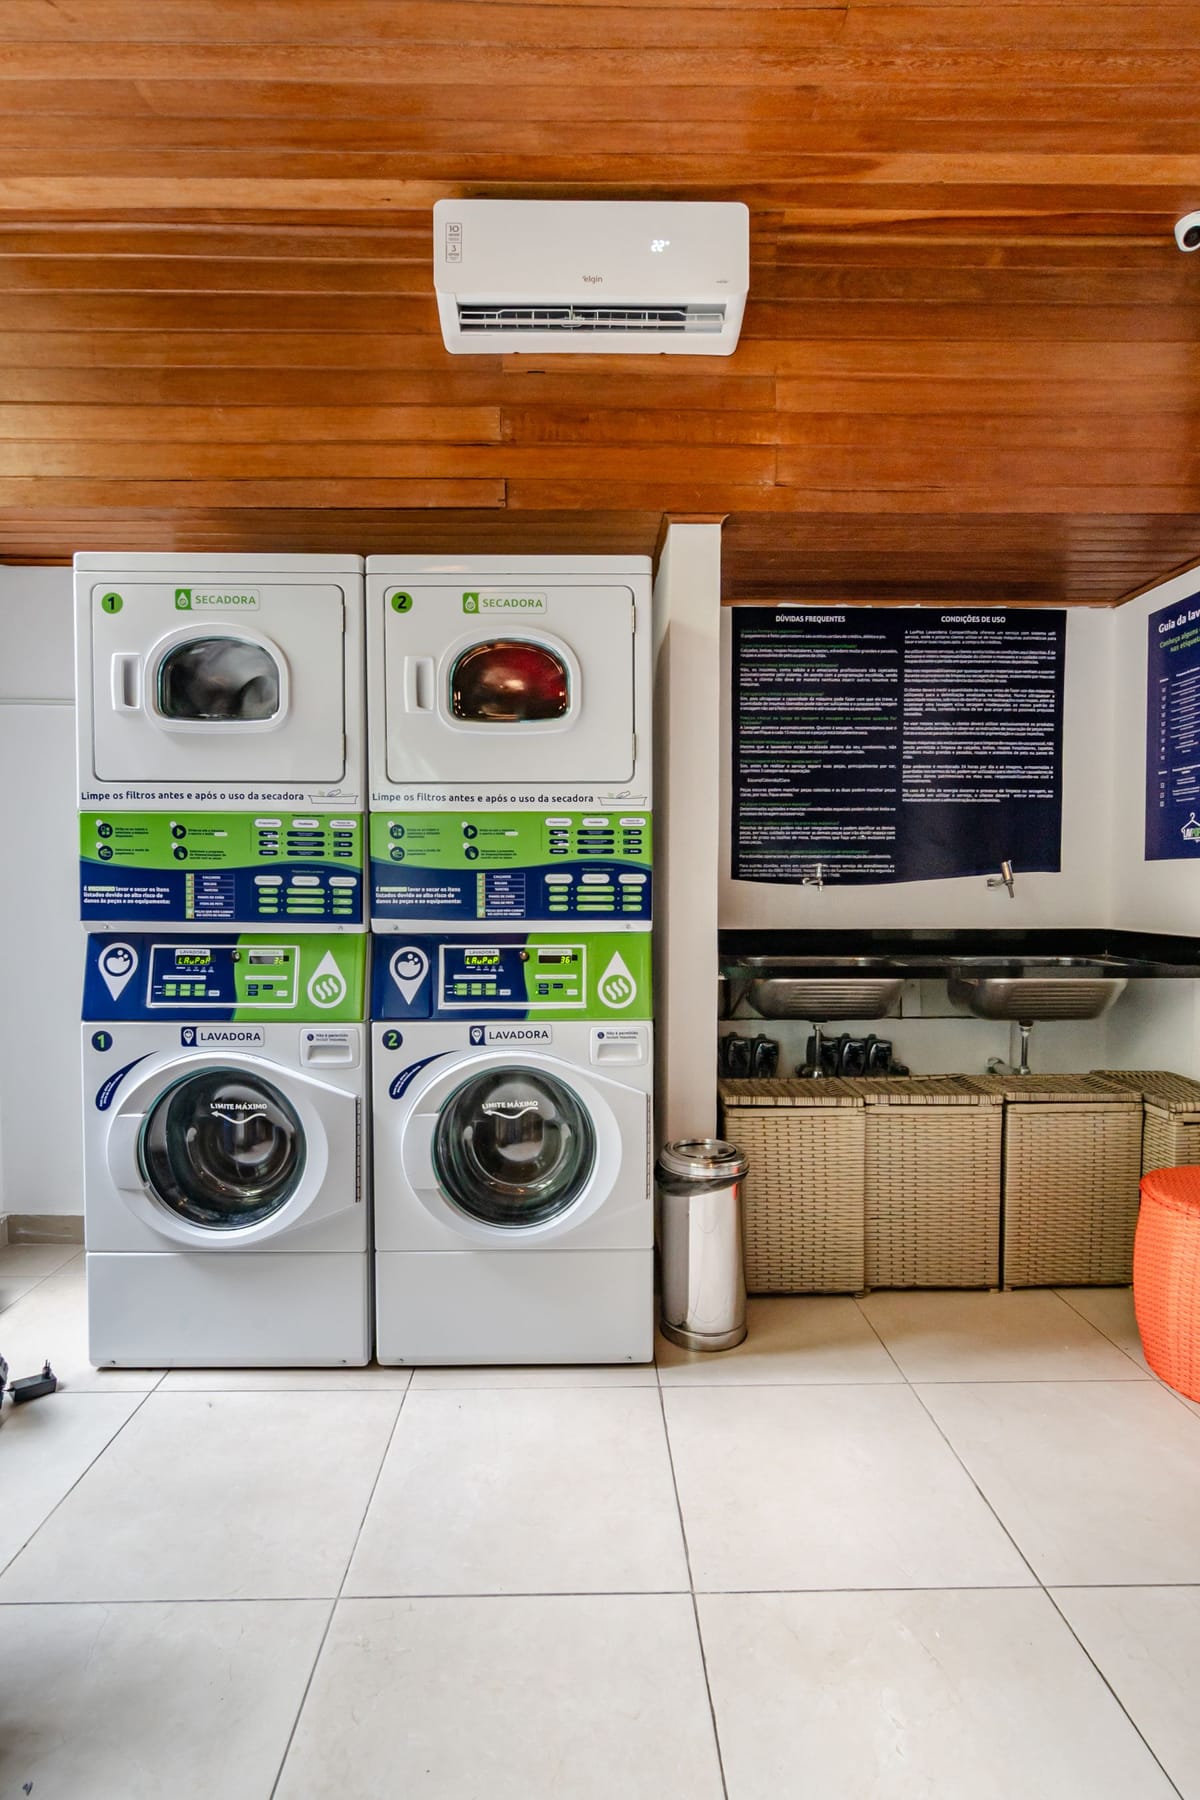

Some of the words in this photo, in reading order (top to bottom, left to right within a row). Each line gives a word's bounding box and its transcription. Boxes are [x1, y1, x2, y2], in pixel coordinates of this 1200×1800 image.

[449, 225, 459, 233] 10
[583, 275, 603, 285] elgin
[107, 596, 115, 610] 1
[195, 595, 256, 605] SECADORA
[398, 595, 407, 609] 2
[482, 598, 543, 608] SECADORA
[775, 614, 804, 623] DÚVIDAS
[805, 615, 846, 624] FREQUENTES
[941, 614, 981, 624] CONDIÇÕES
[1159, 619, 1176, 633] Guia
[1177, 614, 1187, 626] da
[81, 791, 110, 802] Limpe
[126, 790, 156, 800] filtros
[158, 792, 185, 800] antes
[195, 791, 218, 803] após
[249, 791, 259, 800] da
[261, 790, 304, 801] secadora
[372, 792, 401, 803] Limpe
[403, 794, 415, 802] os
[416, 791, 447, 802] filtros
[448, 793, 476, 803] antes
[485, 792, 508, 804] após
[518, 795, 536, 803] uso
[538, 792, 549, 802] da
[551, 792, 594, 803] secadora
[201, 1032, 261, 1041] LAVADORA
[388, 1034, 397, 1046] 2
[489, 1030, 549, 1040] LAVADORA
[97, 1035, 105, 1048] 1
[235, 1101, 268, 1110] MÁXIMO
[481, 1102, 506, 1110] LIMITE
[506, 1099, 538, 1108] MÁXIMO
